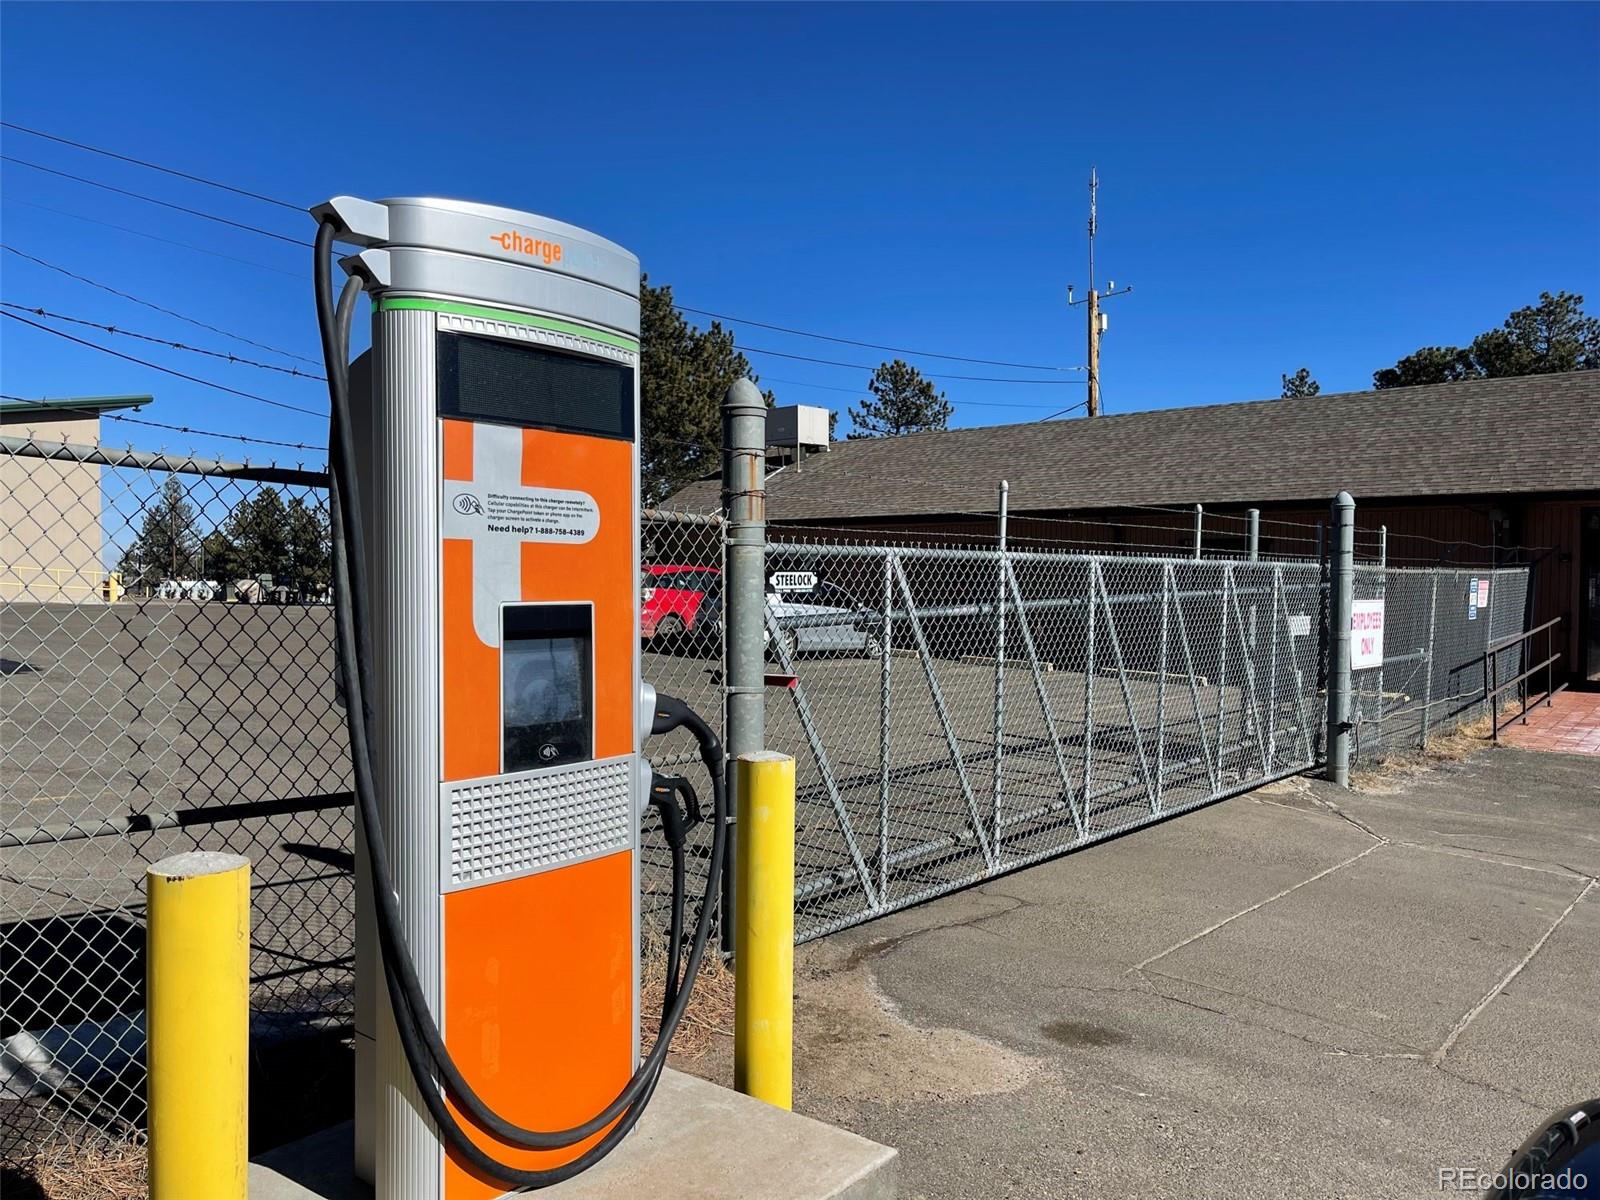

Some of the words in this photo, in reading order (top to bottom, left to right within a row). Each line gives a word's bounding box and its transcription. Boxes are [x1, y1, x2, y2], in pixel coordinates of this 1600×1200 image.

[501, 230, 562, 264] charge
[488, 524, 510, 533] Need
[512, 526, 534, 535] help?
[535, 527, 585, 536] 1-888-758-4389
[776, 574, 812, 586] STEELOCK
[1352, 612, 1382, 630] EMPLOYEES
[1360, 638, 1375, 656] ONLY
